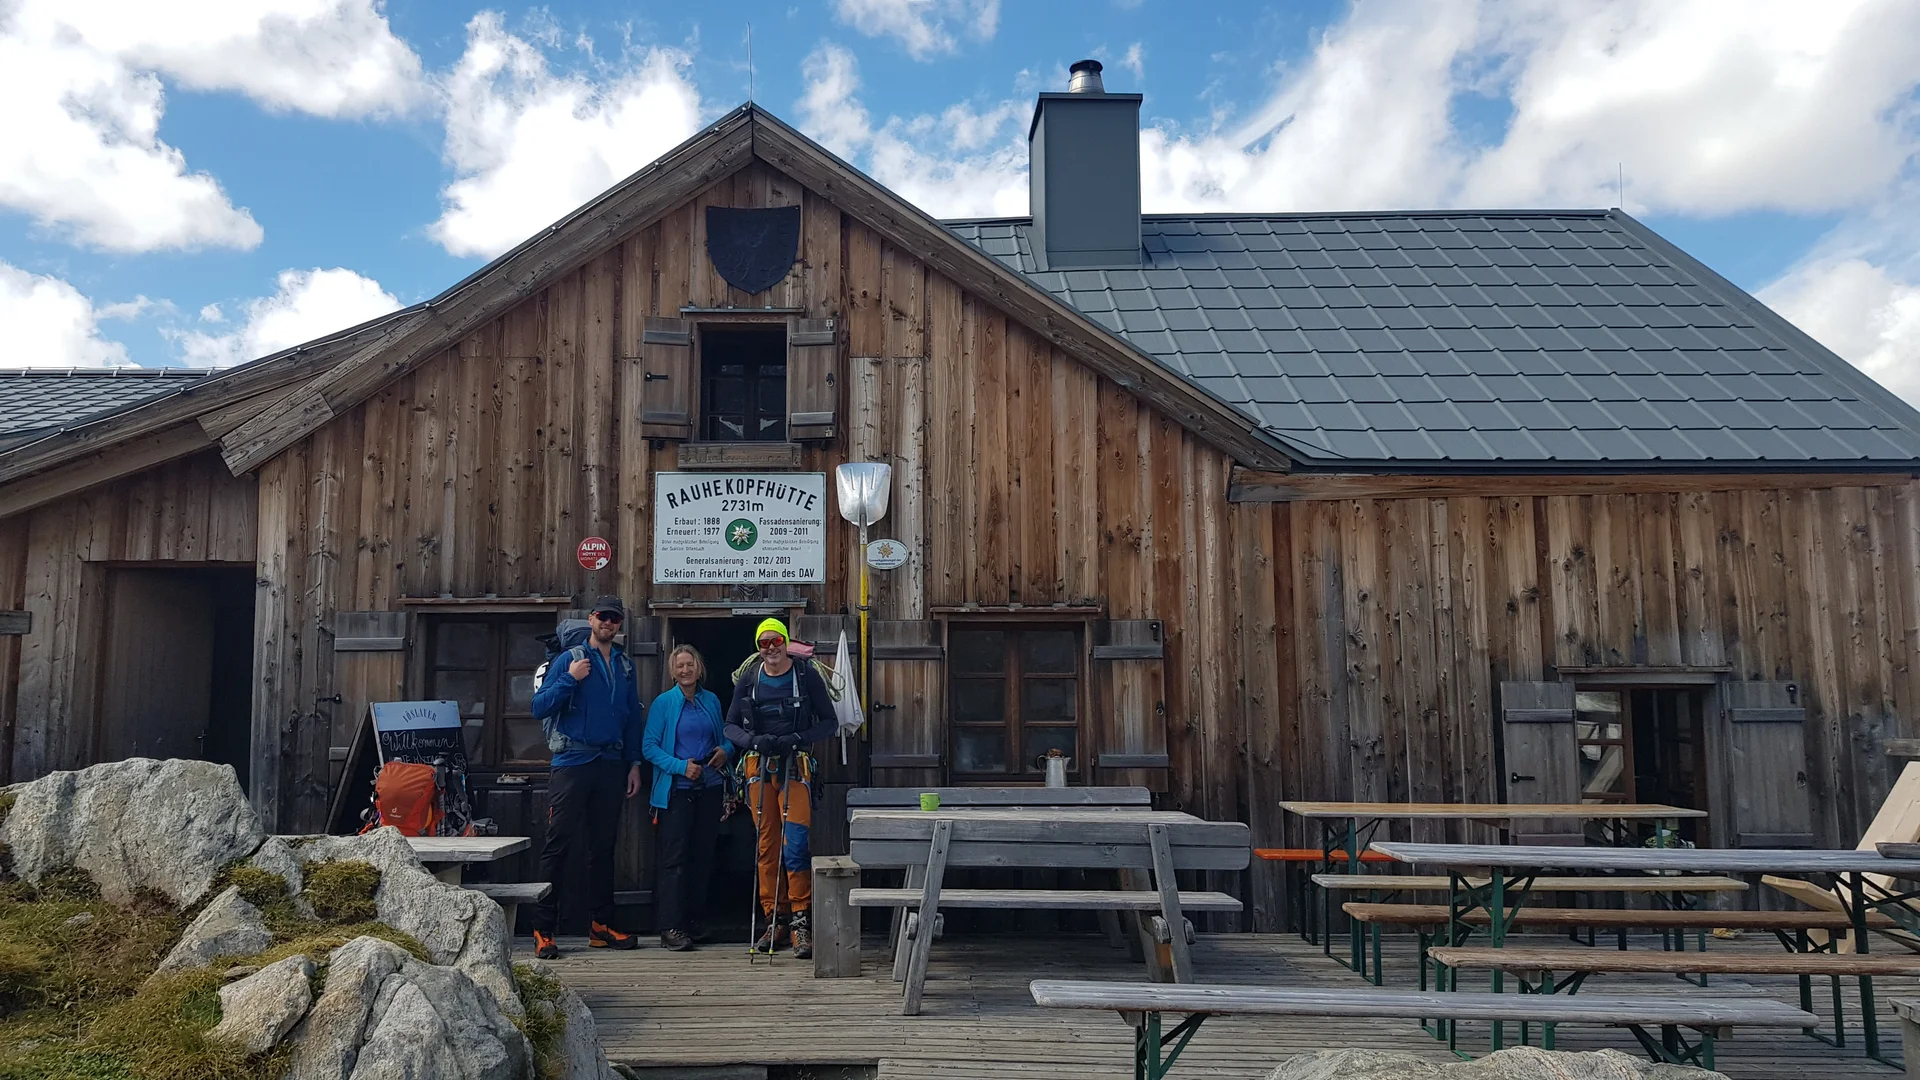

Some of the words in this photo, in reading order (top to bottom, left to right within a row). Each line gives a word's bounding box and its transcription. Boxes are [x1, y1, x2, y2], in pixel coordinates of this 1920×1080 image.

[666, 478, 817, 511] RAUHEKOPFHÜTTE
[722, 500, 764, 512] 2731m
[759, 518, 822, 526] Fassadensanierung:
[664, 569, 695, 578] Sektion
[700, 569, 738, 578] Frankfurt
[759, 569, 778, 578] Main
[782, 569, 795, 578] des
[799, 569, 814, 578] DAV
